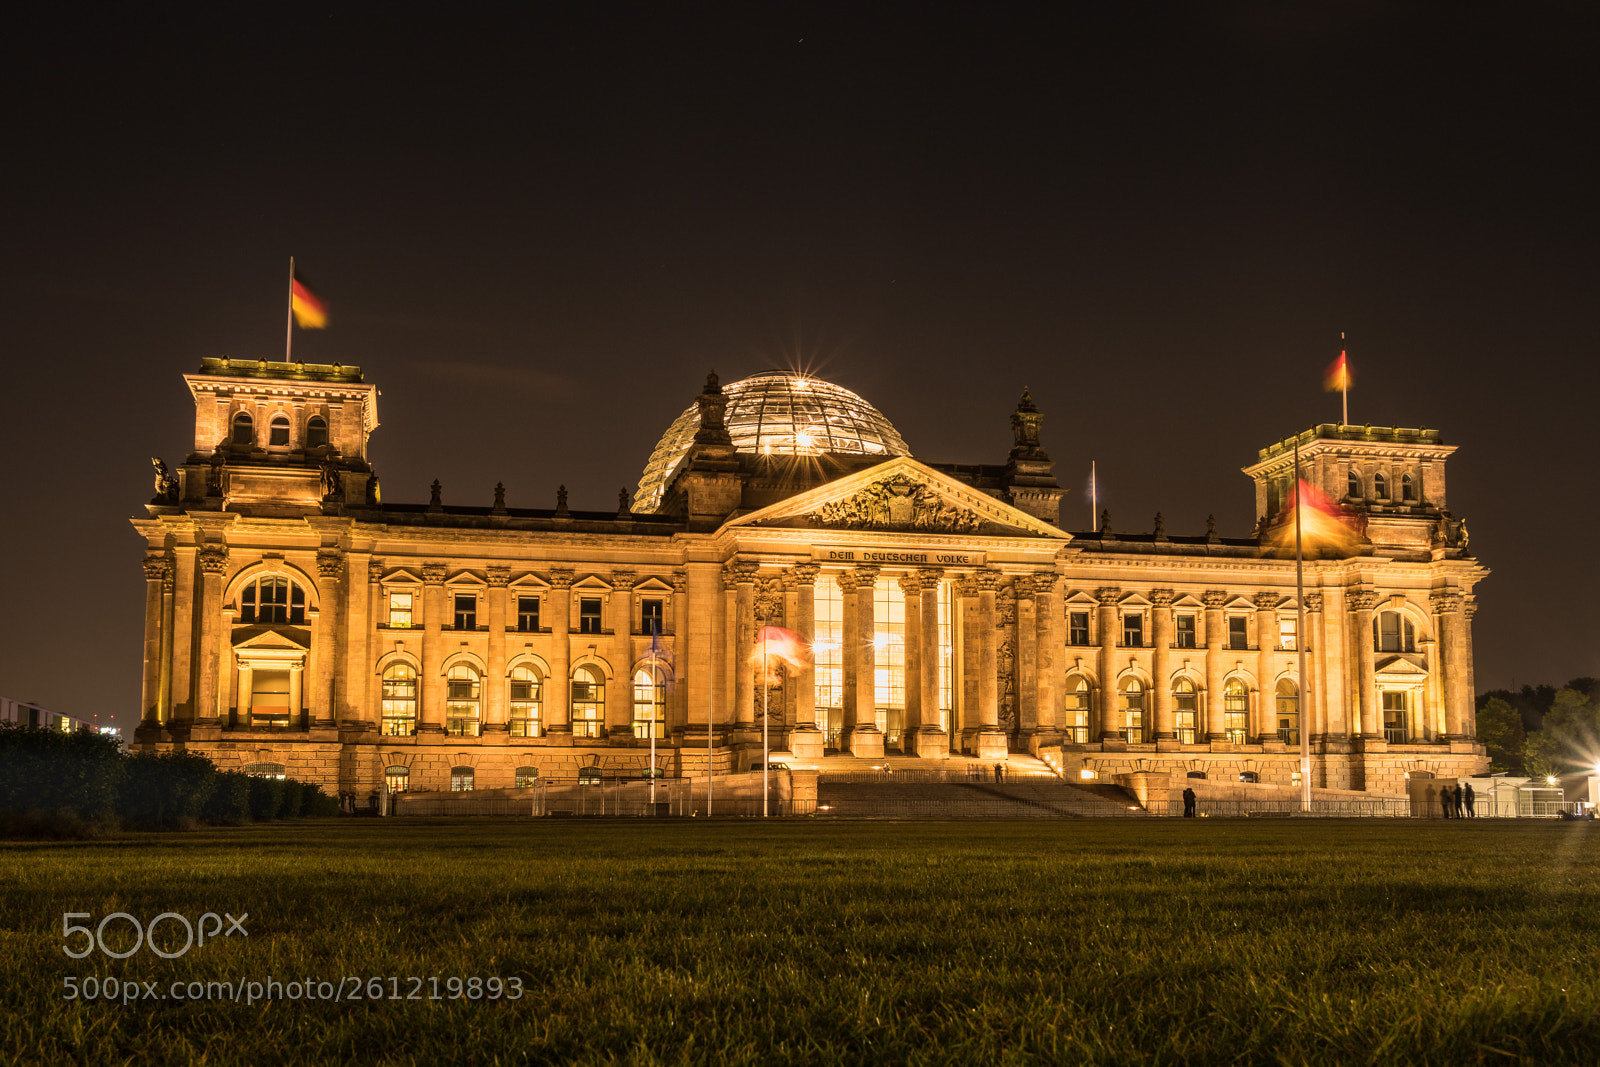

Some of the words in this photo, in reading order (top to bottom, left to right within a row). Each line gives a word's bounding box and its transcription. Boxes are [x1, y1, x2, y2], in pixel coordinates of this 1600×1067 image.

[829, 551, 855, 560] DEM
[863, 552, 927, 563] DEUTSCHEN
[936, 554, 970, 564] VOLKE
